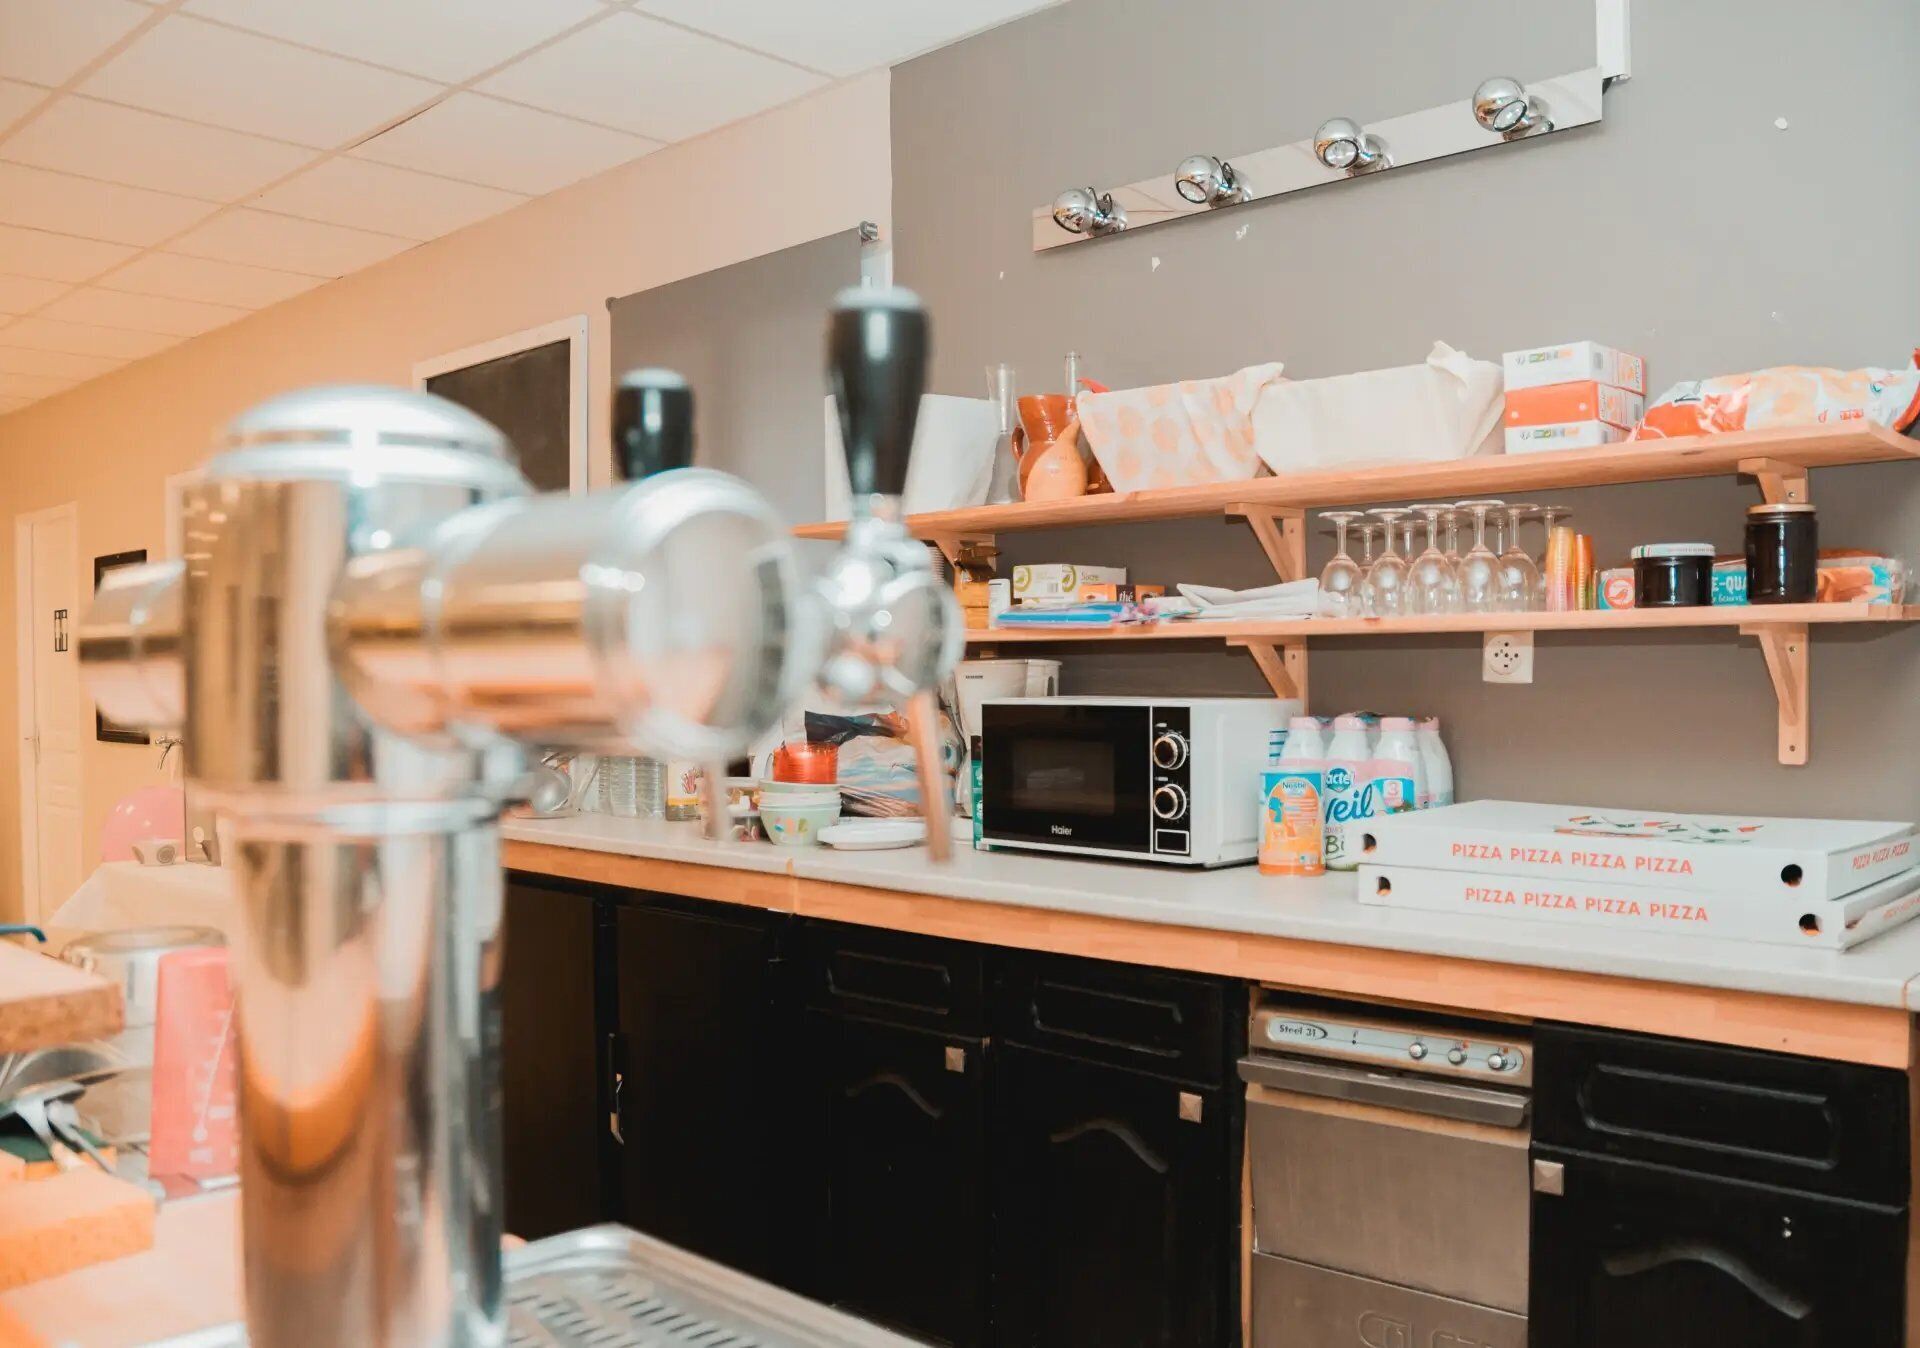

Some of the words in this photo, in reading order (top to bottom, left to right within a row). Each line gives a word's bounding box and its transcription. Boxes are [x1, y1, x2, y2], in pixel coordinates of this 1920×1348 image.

[1051, 825, 1072, 836] Haier
[1452, 843, 1502, 860] PIZZA
[1510, 848, 1562, 865] PIZZA
[1571, 852, 1626, 870] PIZZA
[1635, 856, 1693, 875] PIZZA
[1465, 887, 1516, 905] PIZZA
[1524, 892, 1577, 910] PIZZA
[1585, 897, 1641, 916] PIZZA
[1650, 903, 1708, 921] PIZZA
[1279, 1024, 1302, 1035] Steel
